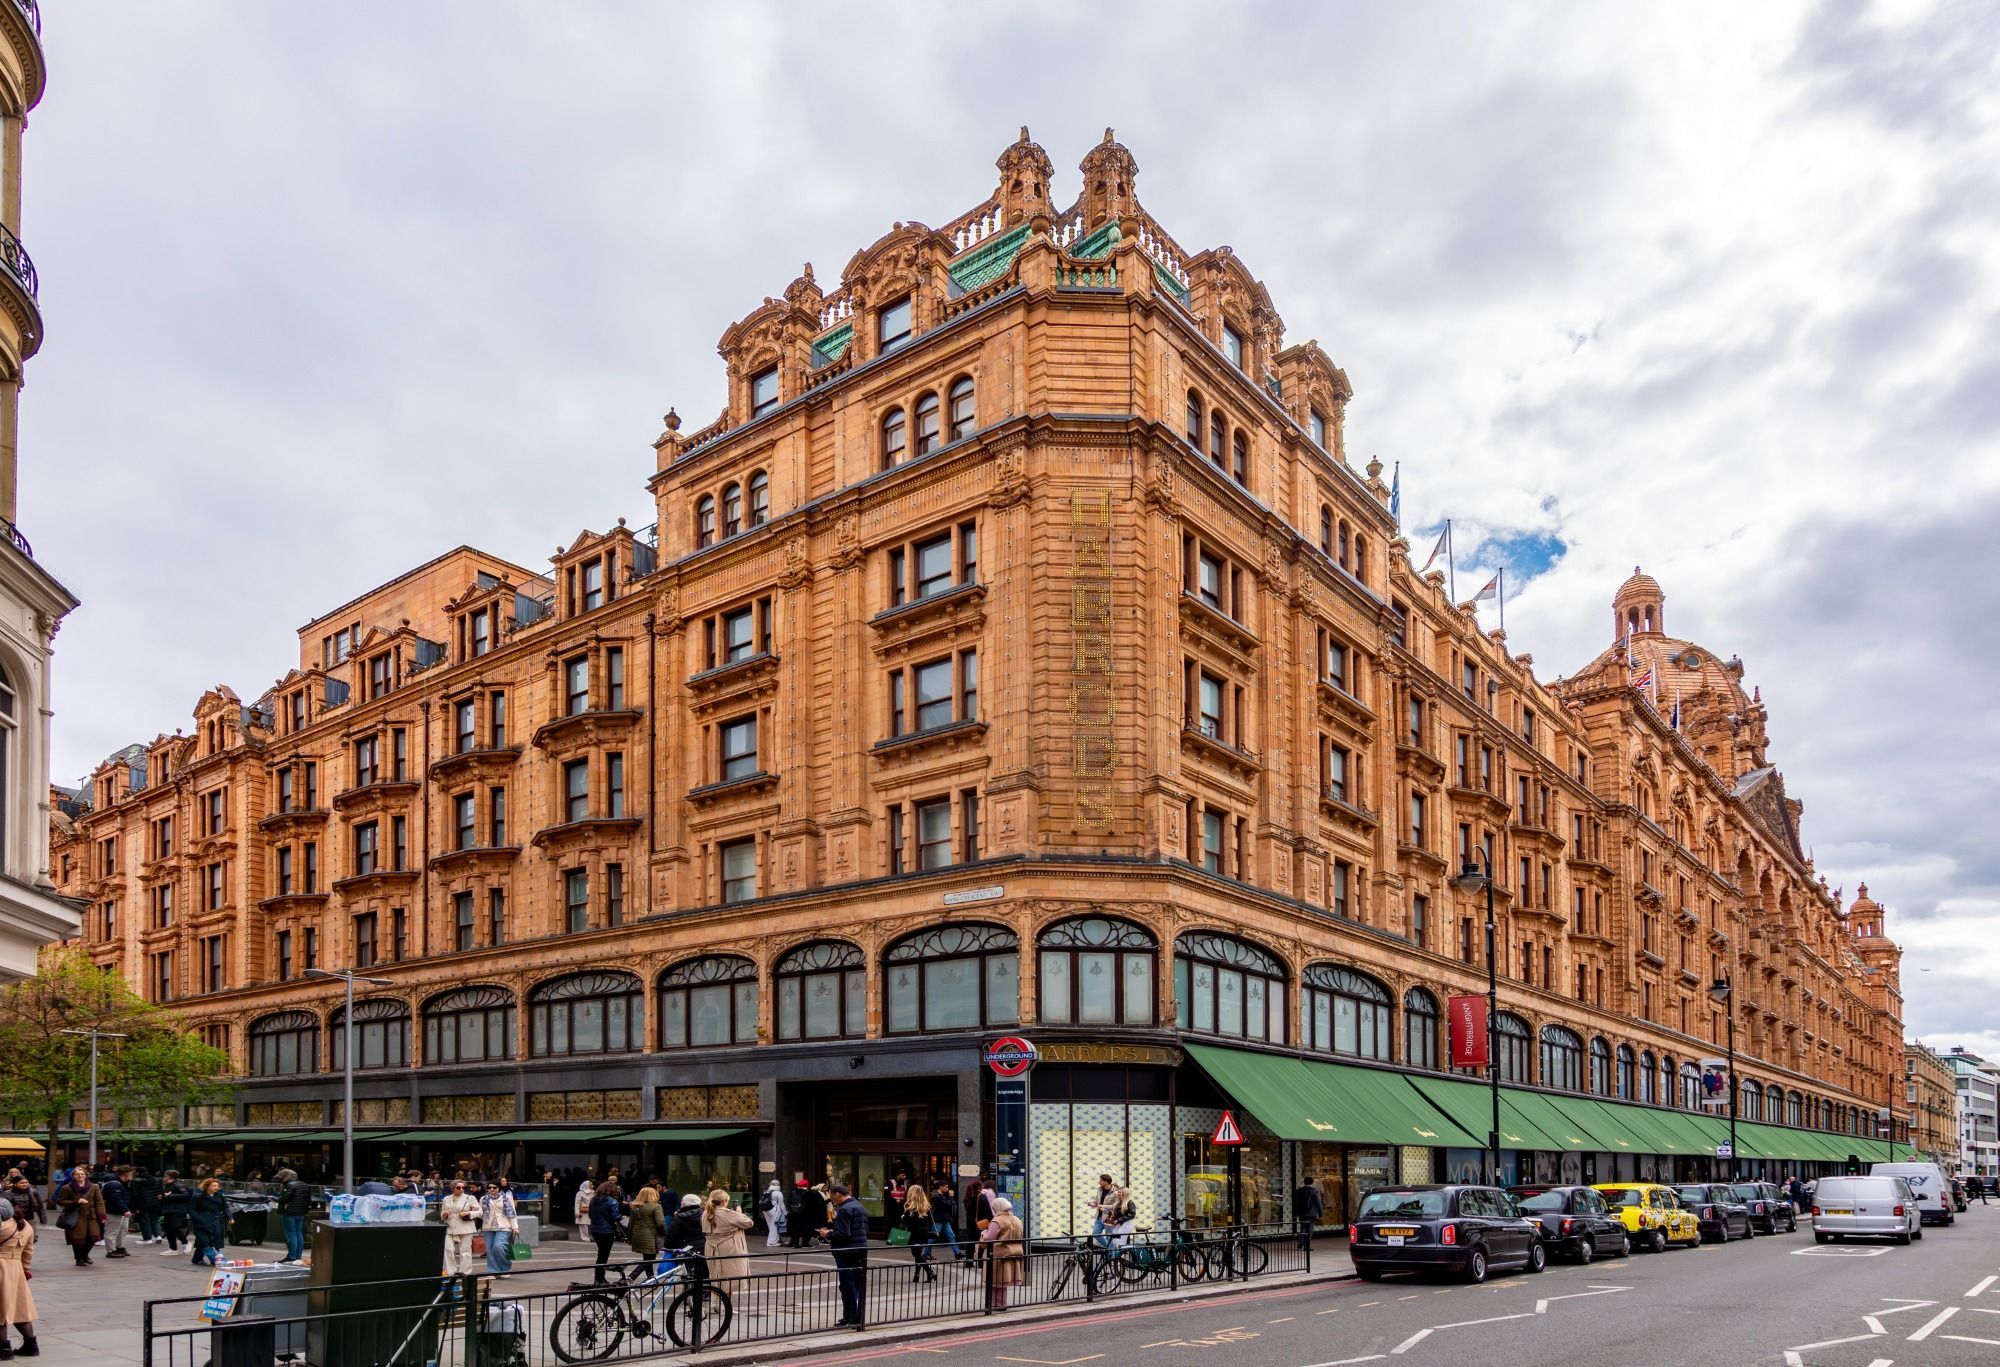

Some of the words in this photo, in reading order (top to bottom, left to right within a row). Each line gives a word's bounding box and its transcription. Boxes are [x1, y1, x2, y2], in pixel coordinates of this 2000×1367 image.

[1066, 488, 1120, 829] HARRODS
[985, 1052, 1033, 1060] UNDERGROUND
[1462, 1002, 1475, 1056] KNIGHTSBRIDGE
